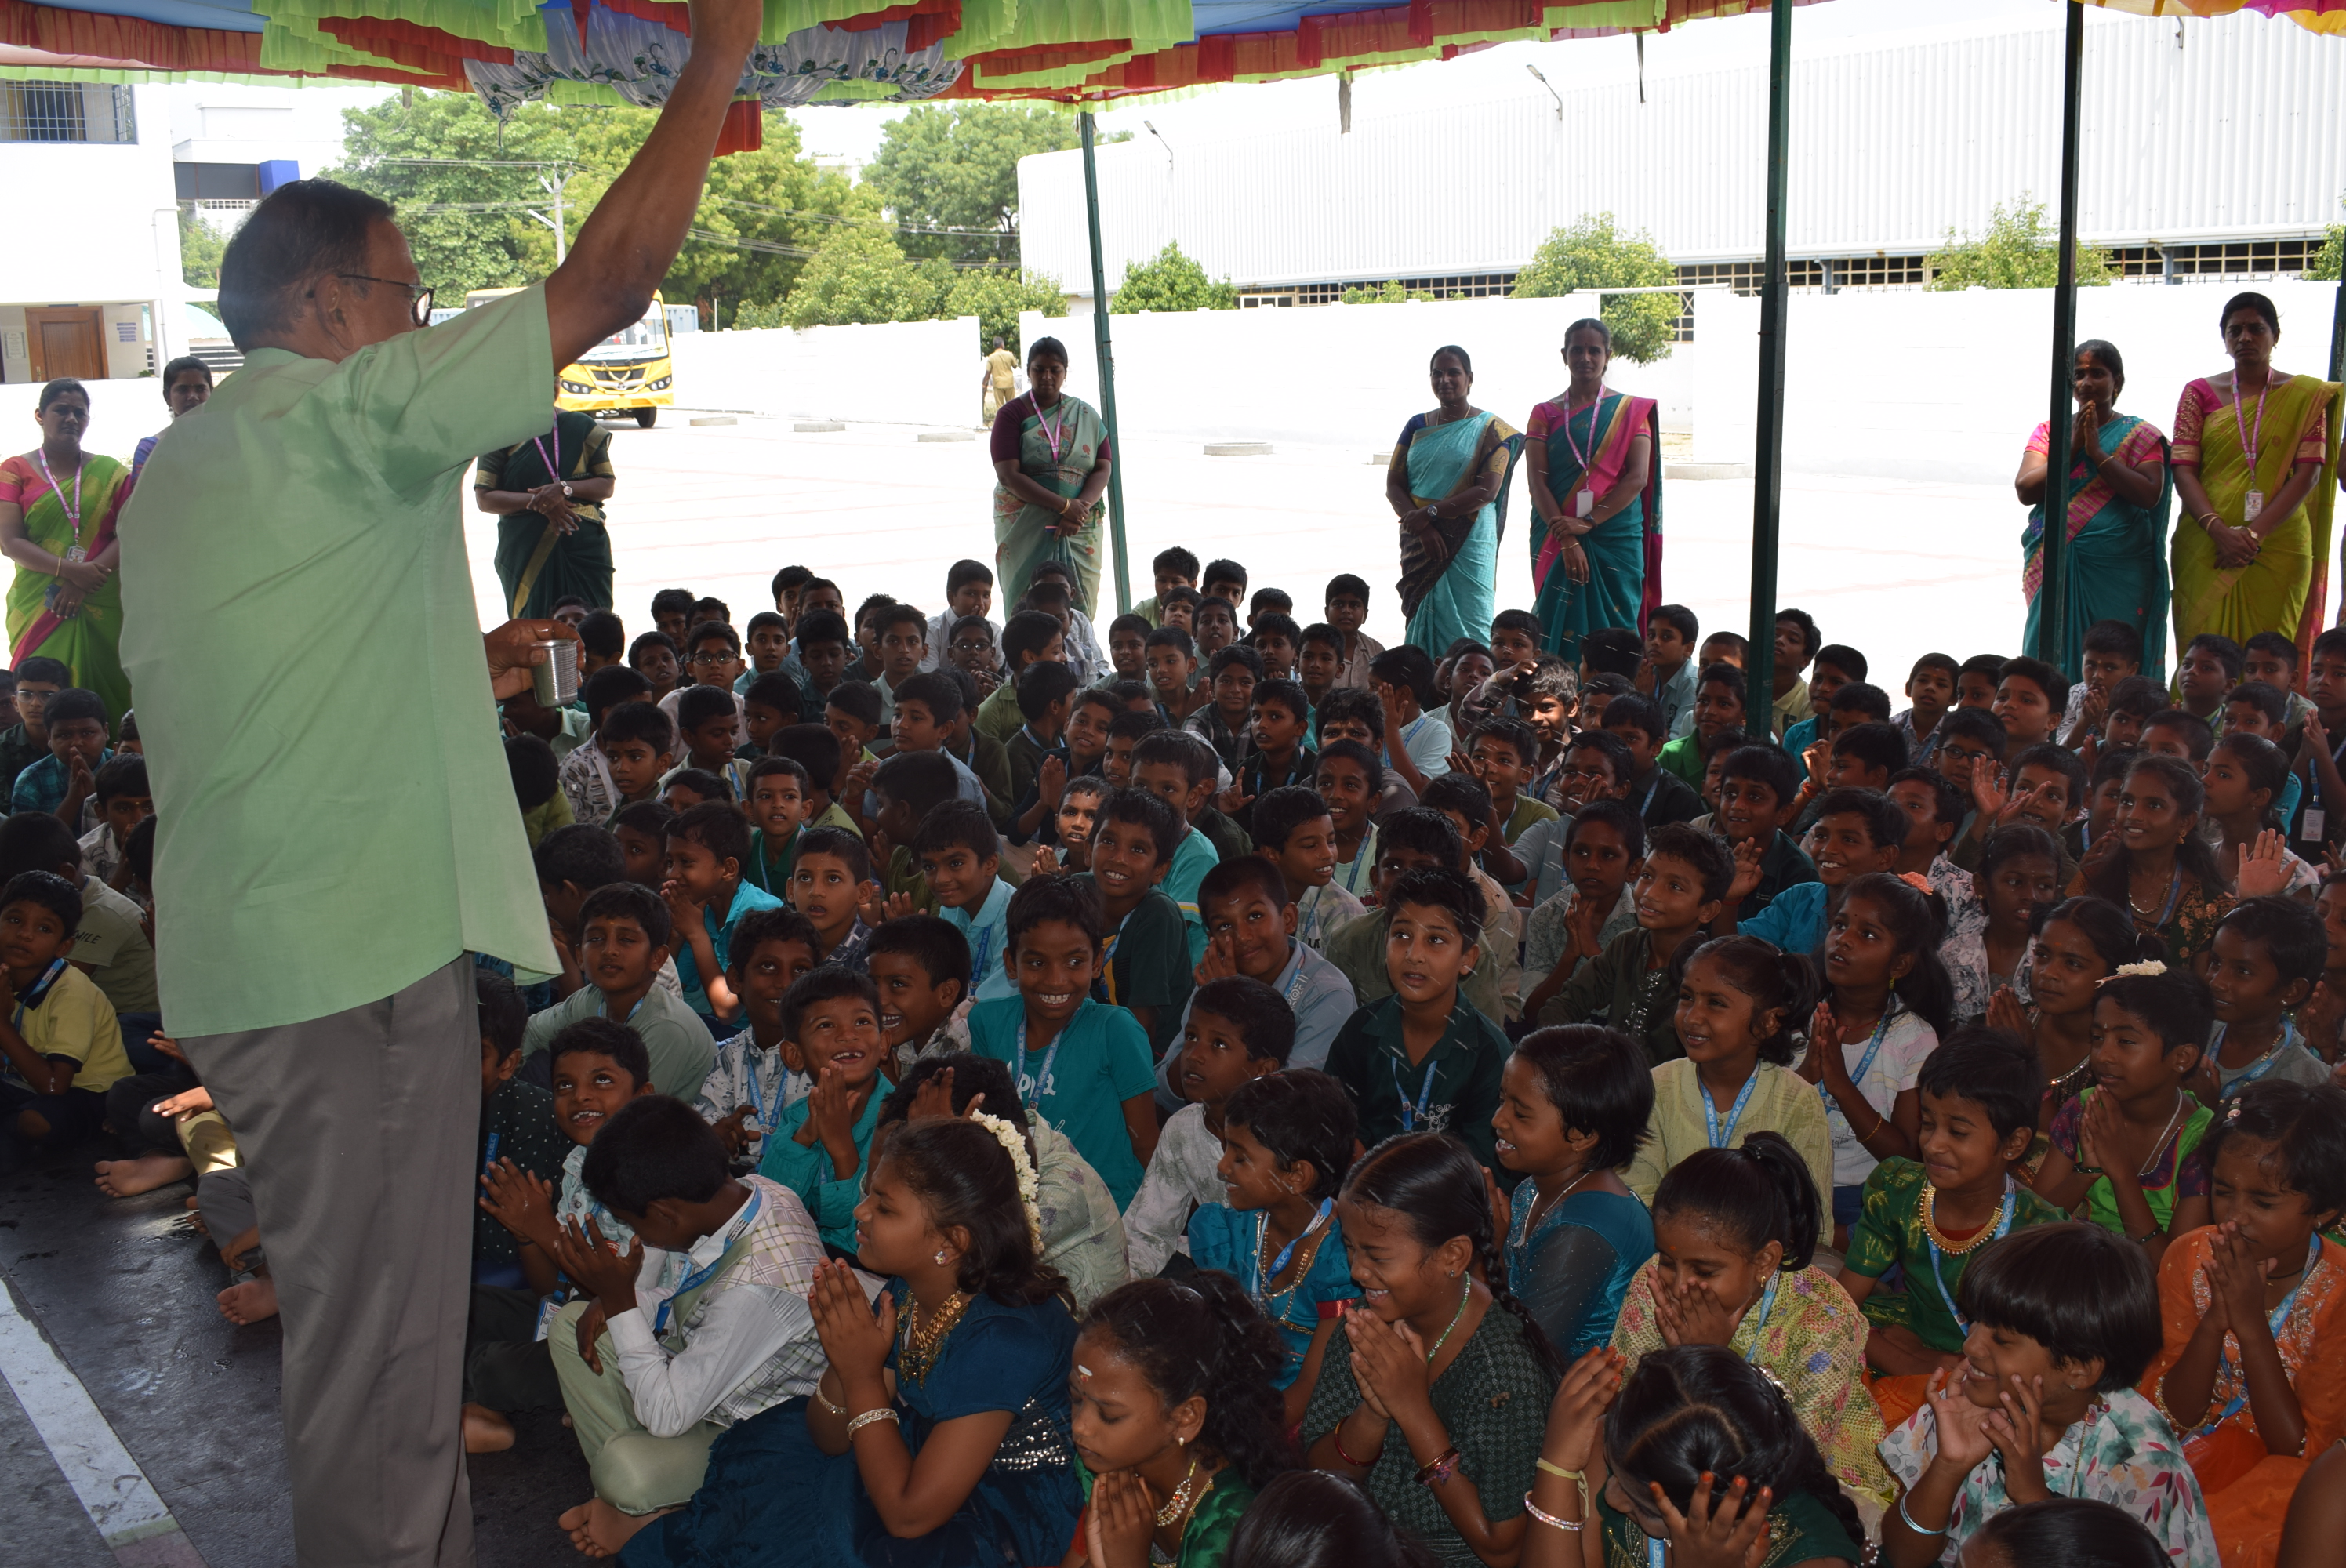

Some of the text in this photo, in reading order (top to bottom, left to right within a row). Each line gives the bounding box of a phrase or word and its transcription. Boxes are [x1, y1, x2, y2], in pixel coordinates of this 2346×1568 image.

[1851, 1038, 1879, 1084] AVENDRA PUBLIC
[2250, 1062, 2272, 1080] SCHOOL
[1706, 1100, 1715, 1123] PUBLIC
[1721, 1082, 1756, 1149] VENDRA PUBLIC SCHOOL
[2002, 1196, 2014, 1223] SCHOOL
[698, 1265, 715, 1283] PUBLIC
[2271, 1302, 2289, 1328] PUBLIC
[1652, 1539, 1662, 1568] RAGAV
